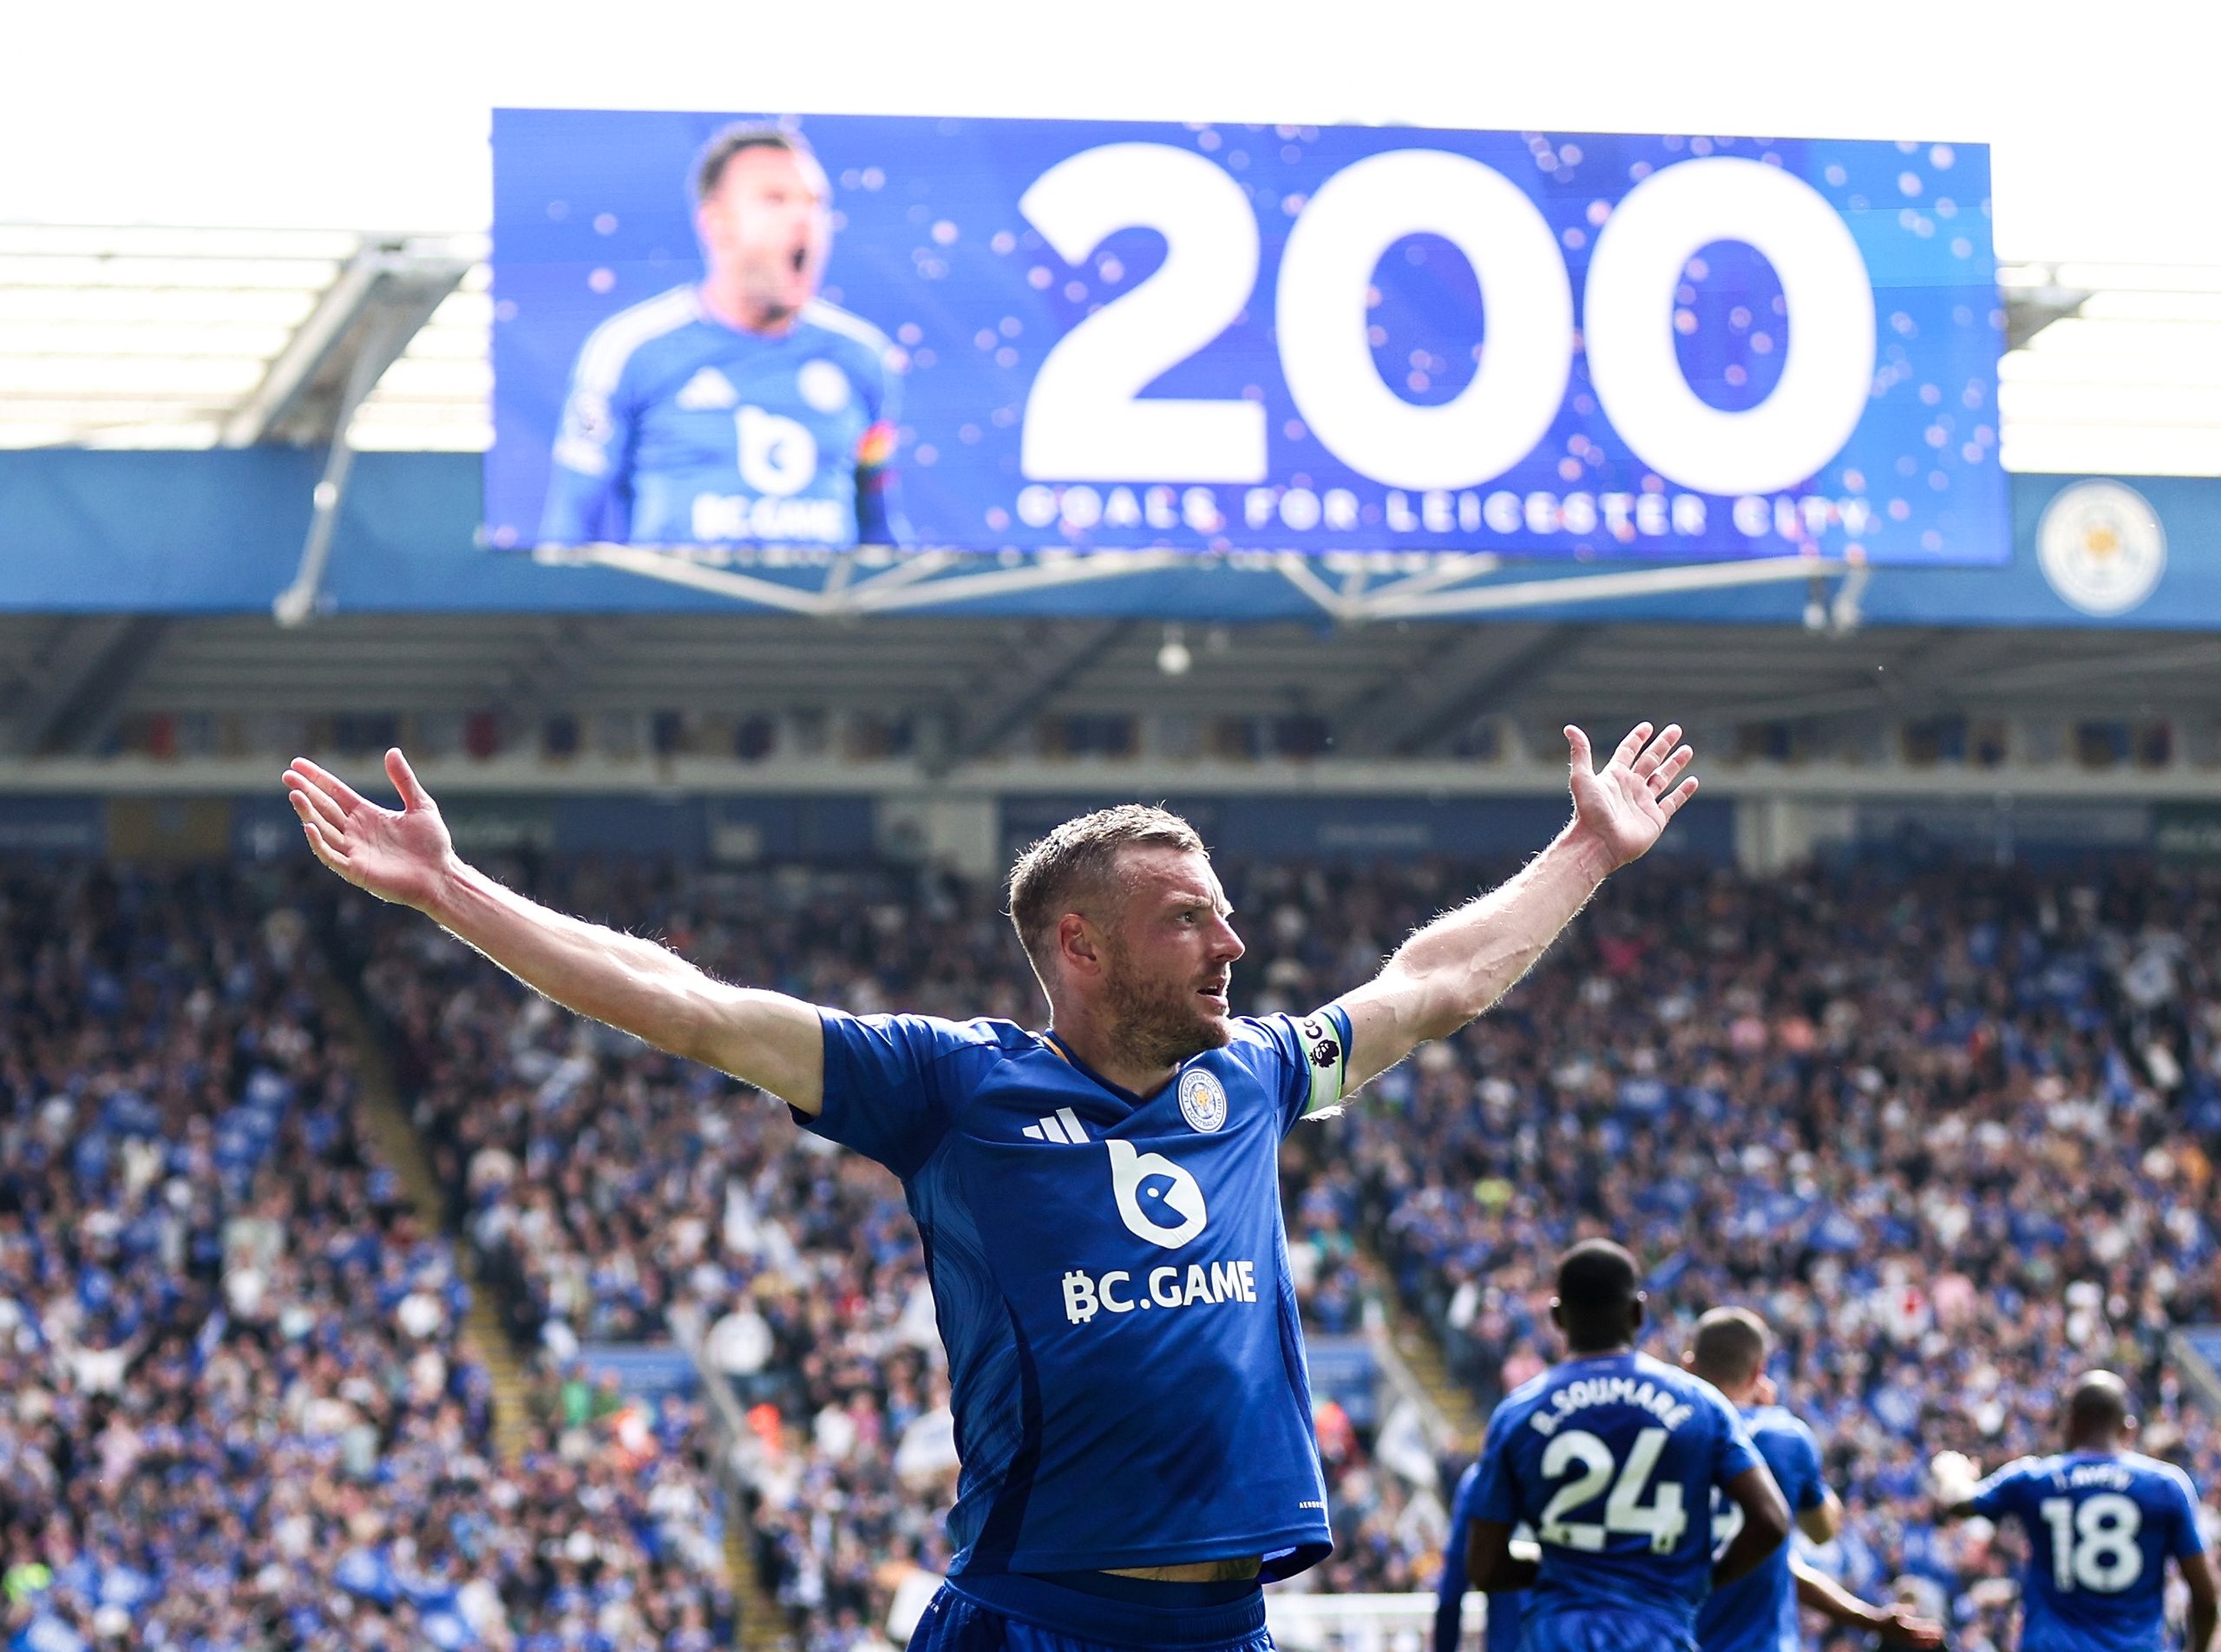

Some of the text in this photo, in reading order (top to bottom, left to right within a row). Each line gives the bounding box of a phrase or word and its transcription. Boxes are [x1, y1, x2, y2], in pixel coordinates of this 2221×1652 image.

[1019, 141, 1877, 497] 200
[1017, 484, 1870, 537] GOALS FOR LEICESTER CITY
[1540, 1428, 1686, 1555] 24
[2041, 1492, 2143, 1591] 18
